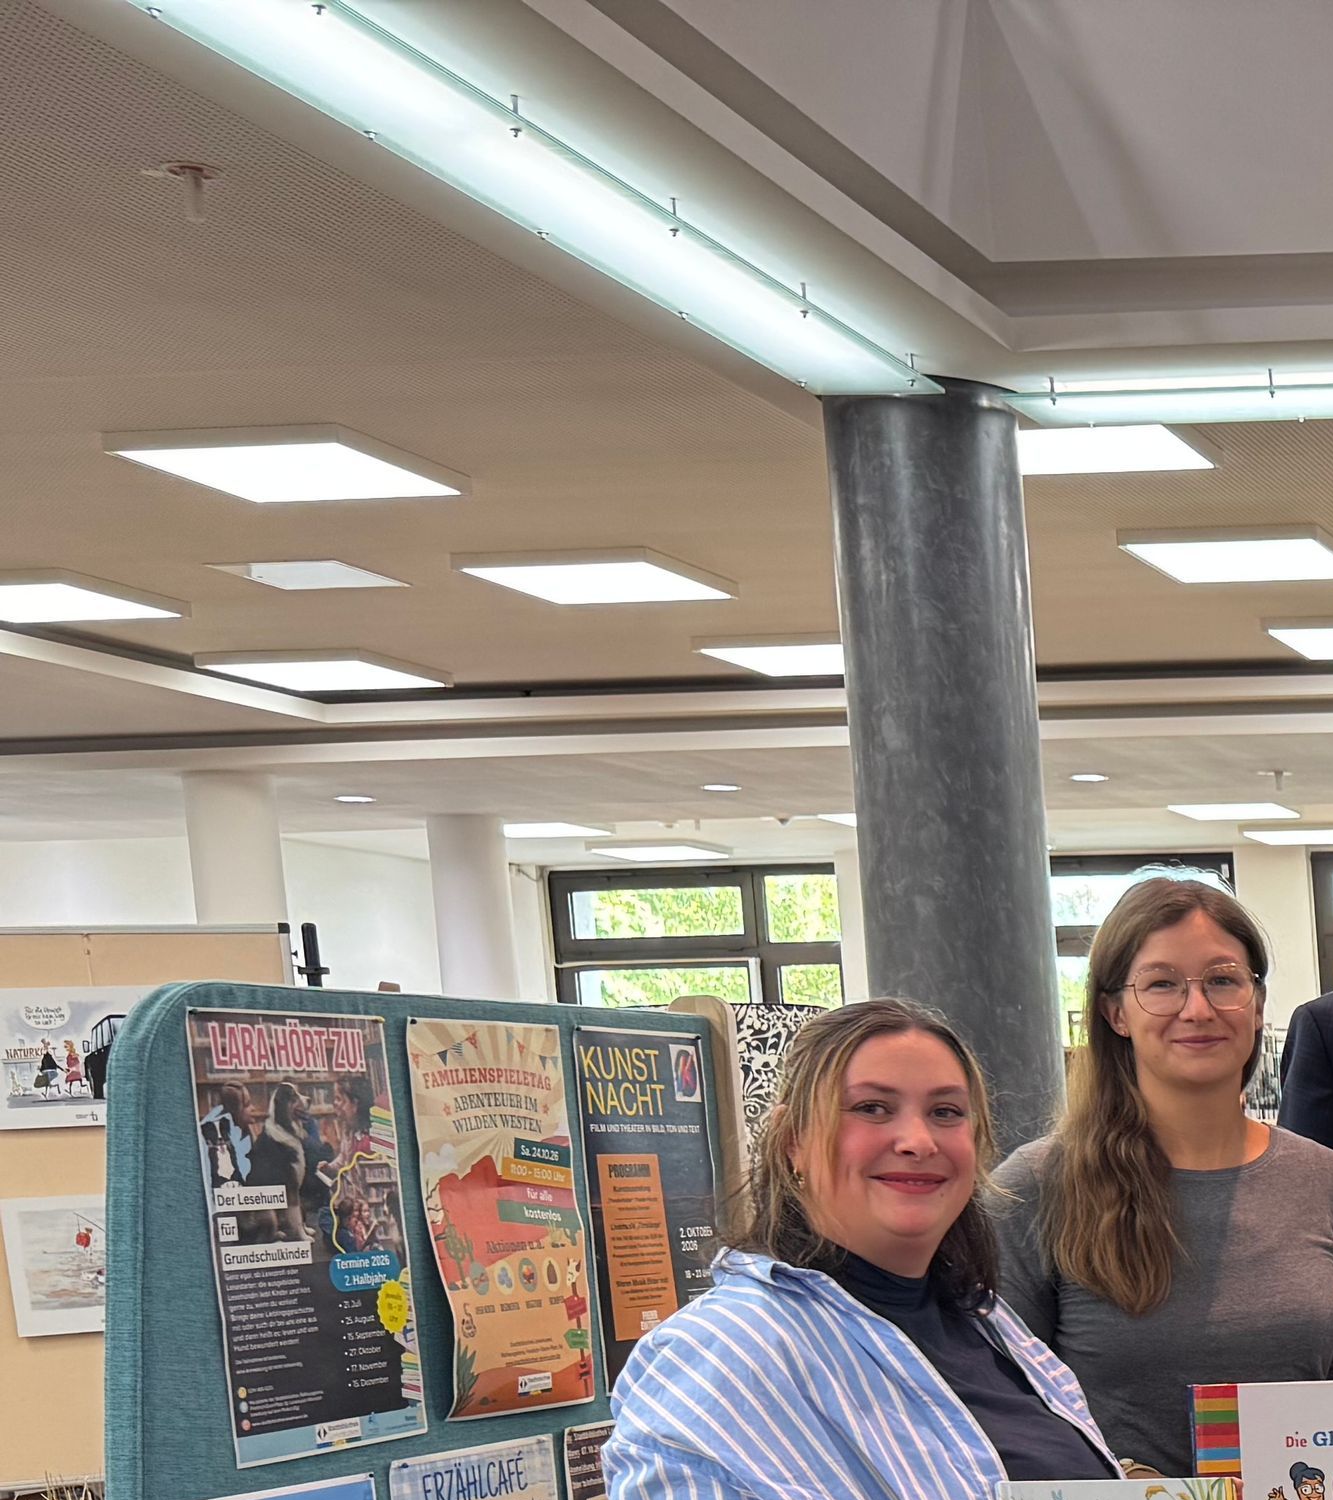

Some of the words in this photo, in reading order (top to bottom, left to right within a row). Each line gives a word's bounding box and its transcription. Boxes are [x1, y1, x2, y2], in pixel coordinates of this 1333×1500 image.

[208, 1021, 273, 1068] LARA
[272, 1019, 329, 1070] HÖRT
[330, 1027, 366, 1072] ZU!
[580, 1045, 659, 1081] KUNST
[423, 1067, 552, 1090] FAMILIENSPIELETAG
[454, 1093, 523, 1113] ABENTEUER
[525, 1096, 538, 1112] IM
[586, 1082, 665, 1116] NACHT
[453, 1114, 498, 1134] WILDEN
[500, 1114, 542, 1134] WESTEN
[590, 1123, 605, 1132] FILM
[521, 1145, 530, 1156] Sa.
[532, 1147, 559, 1161] 24.10.26
[553, 1170, 565, 1182] Uhr
[217, 1195, 235, 1206] Der
[237, 1191, 285, 1205] Lesehund
[526, 1188, 537, 1200] für
[539, 1190, 553, 1202] alle
[524, 1206, 561, 1222] kostenlos
[221, 1223, 235, 1236] für
[224, 1248, 310, 1264] Grundschulkinder
[336, 1258, 370, 1270] Termine
[371, 1255, 390, 1266] 2026
[353, 1273, 387, 1285] Halbjahr
[1286, 1431, 1307, 1448] Die
